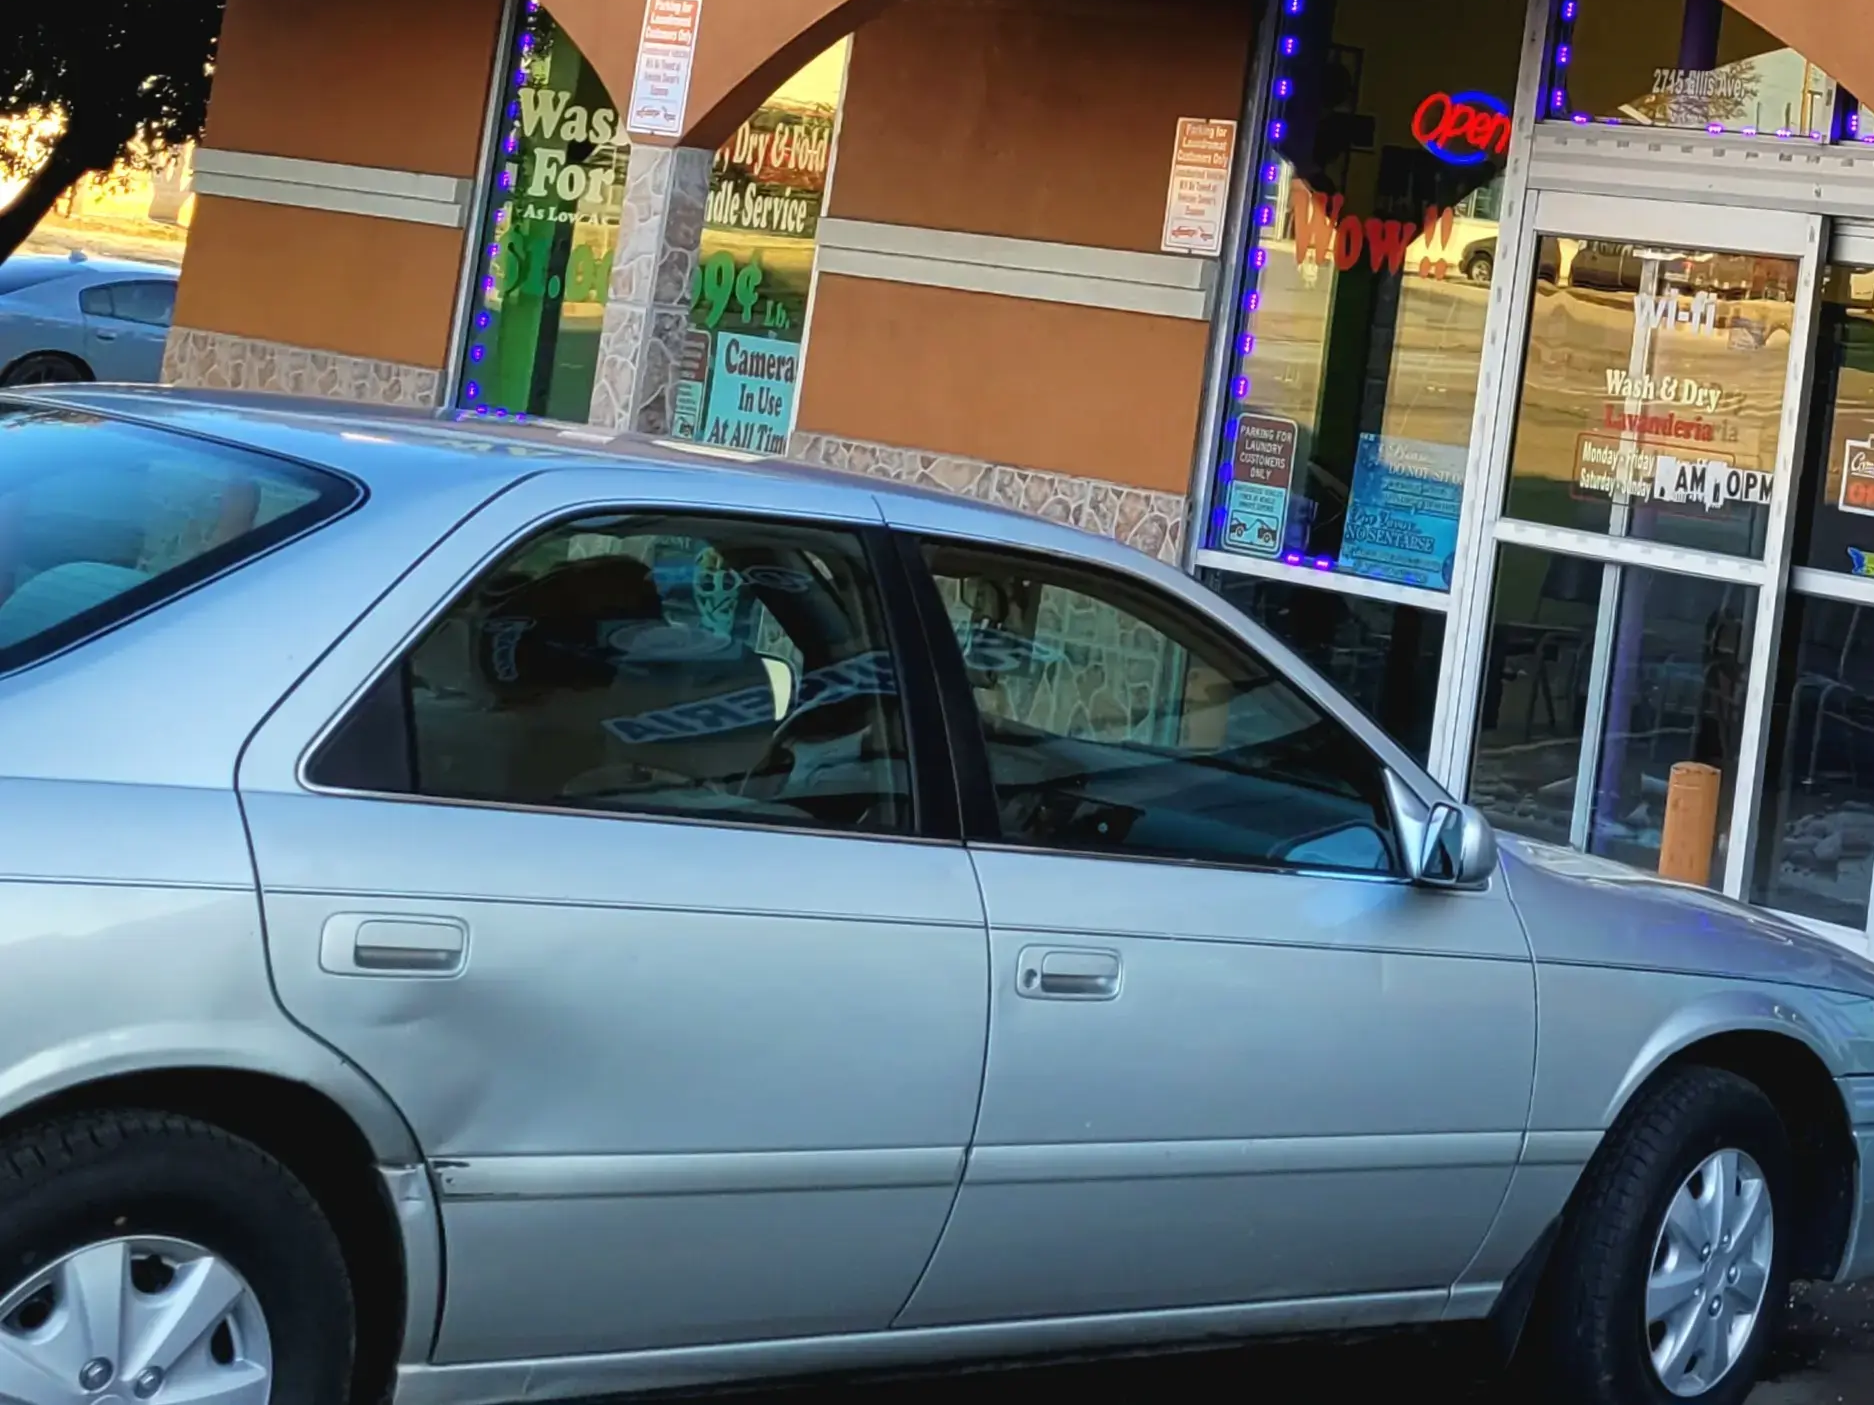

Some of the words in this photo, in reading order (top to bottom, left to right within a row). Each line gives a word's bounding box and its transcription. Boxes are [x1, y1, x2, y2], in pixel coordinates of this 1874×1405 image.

[1411, 92, 1511, 154] Open
[733, 121, 770, 175] Dry
[788, 124, 830, 172] Fold
[527, 147, 616, 202] For
[704, 180, 739, 226] ndle
[741, 182, 807, 232] Service
[725, 338, 799, 383] Camera
[738, 383, 754, 413] In
[758, 386, 782, 417] Use
[1606, 369, 1654, 400] Wash
[1660, 376, 1679, 401] &
[1681, 379, 1721, 414] Dry
[707, 415, 728, 444] At
[730, 419, 753, 448] All
[1240, 425, 1274, 441] PARKING
[1276, 429, 1292, 444] FOR
[1603, 405, 1714, 442] Lavanderia
[1240, 451, 1286, 470] CUSTOMERS
[1245, 440, 1283, 456] LAUNDRY
[1583, 441, 1618, 470] Monday
[1626, 449, 1656, 474] Friday
[1250, 467, 1272, 481] ONLY
[1406, 465, 1429, 479] NOT
[1580, 468, 1615, 497] Saturday
[1675, 465, 1706, 493] AM
